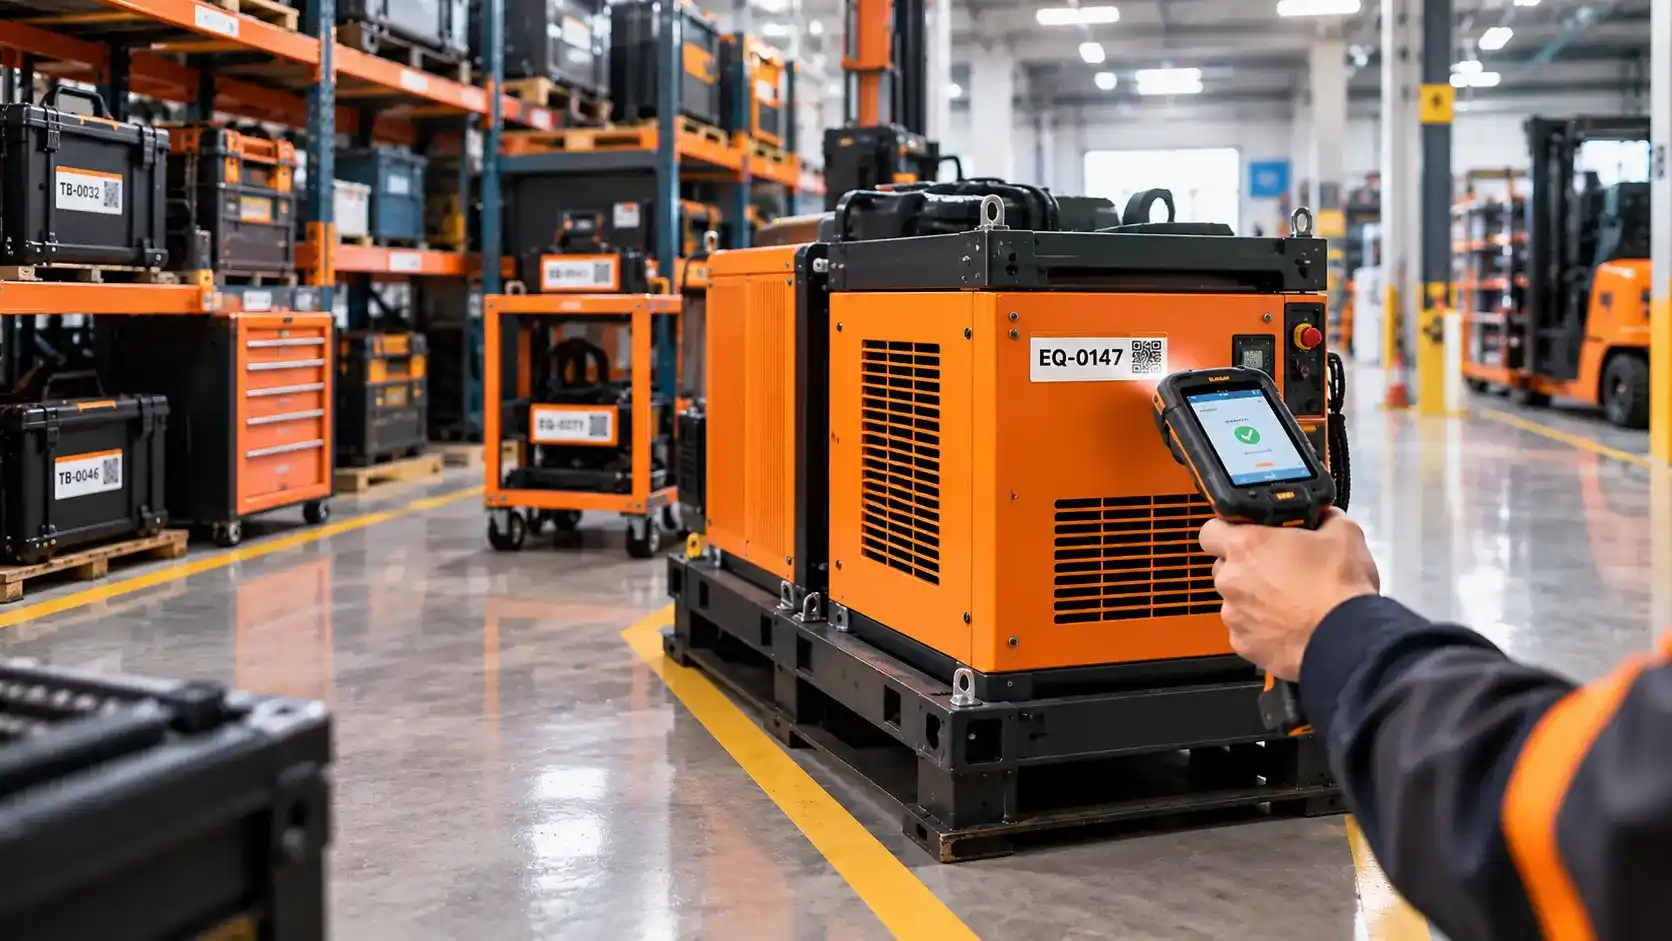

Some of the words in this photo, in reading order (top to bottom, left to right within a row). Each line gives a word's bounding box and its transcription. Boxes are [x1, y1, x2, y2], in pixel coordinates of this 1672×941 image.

[60, 182, 99, 199] TB-0032
[1039, 349, 1123, 366] EQ-0147
[59, 468, 99, 485] TB-0046
